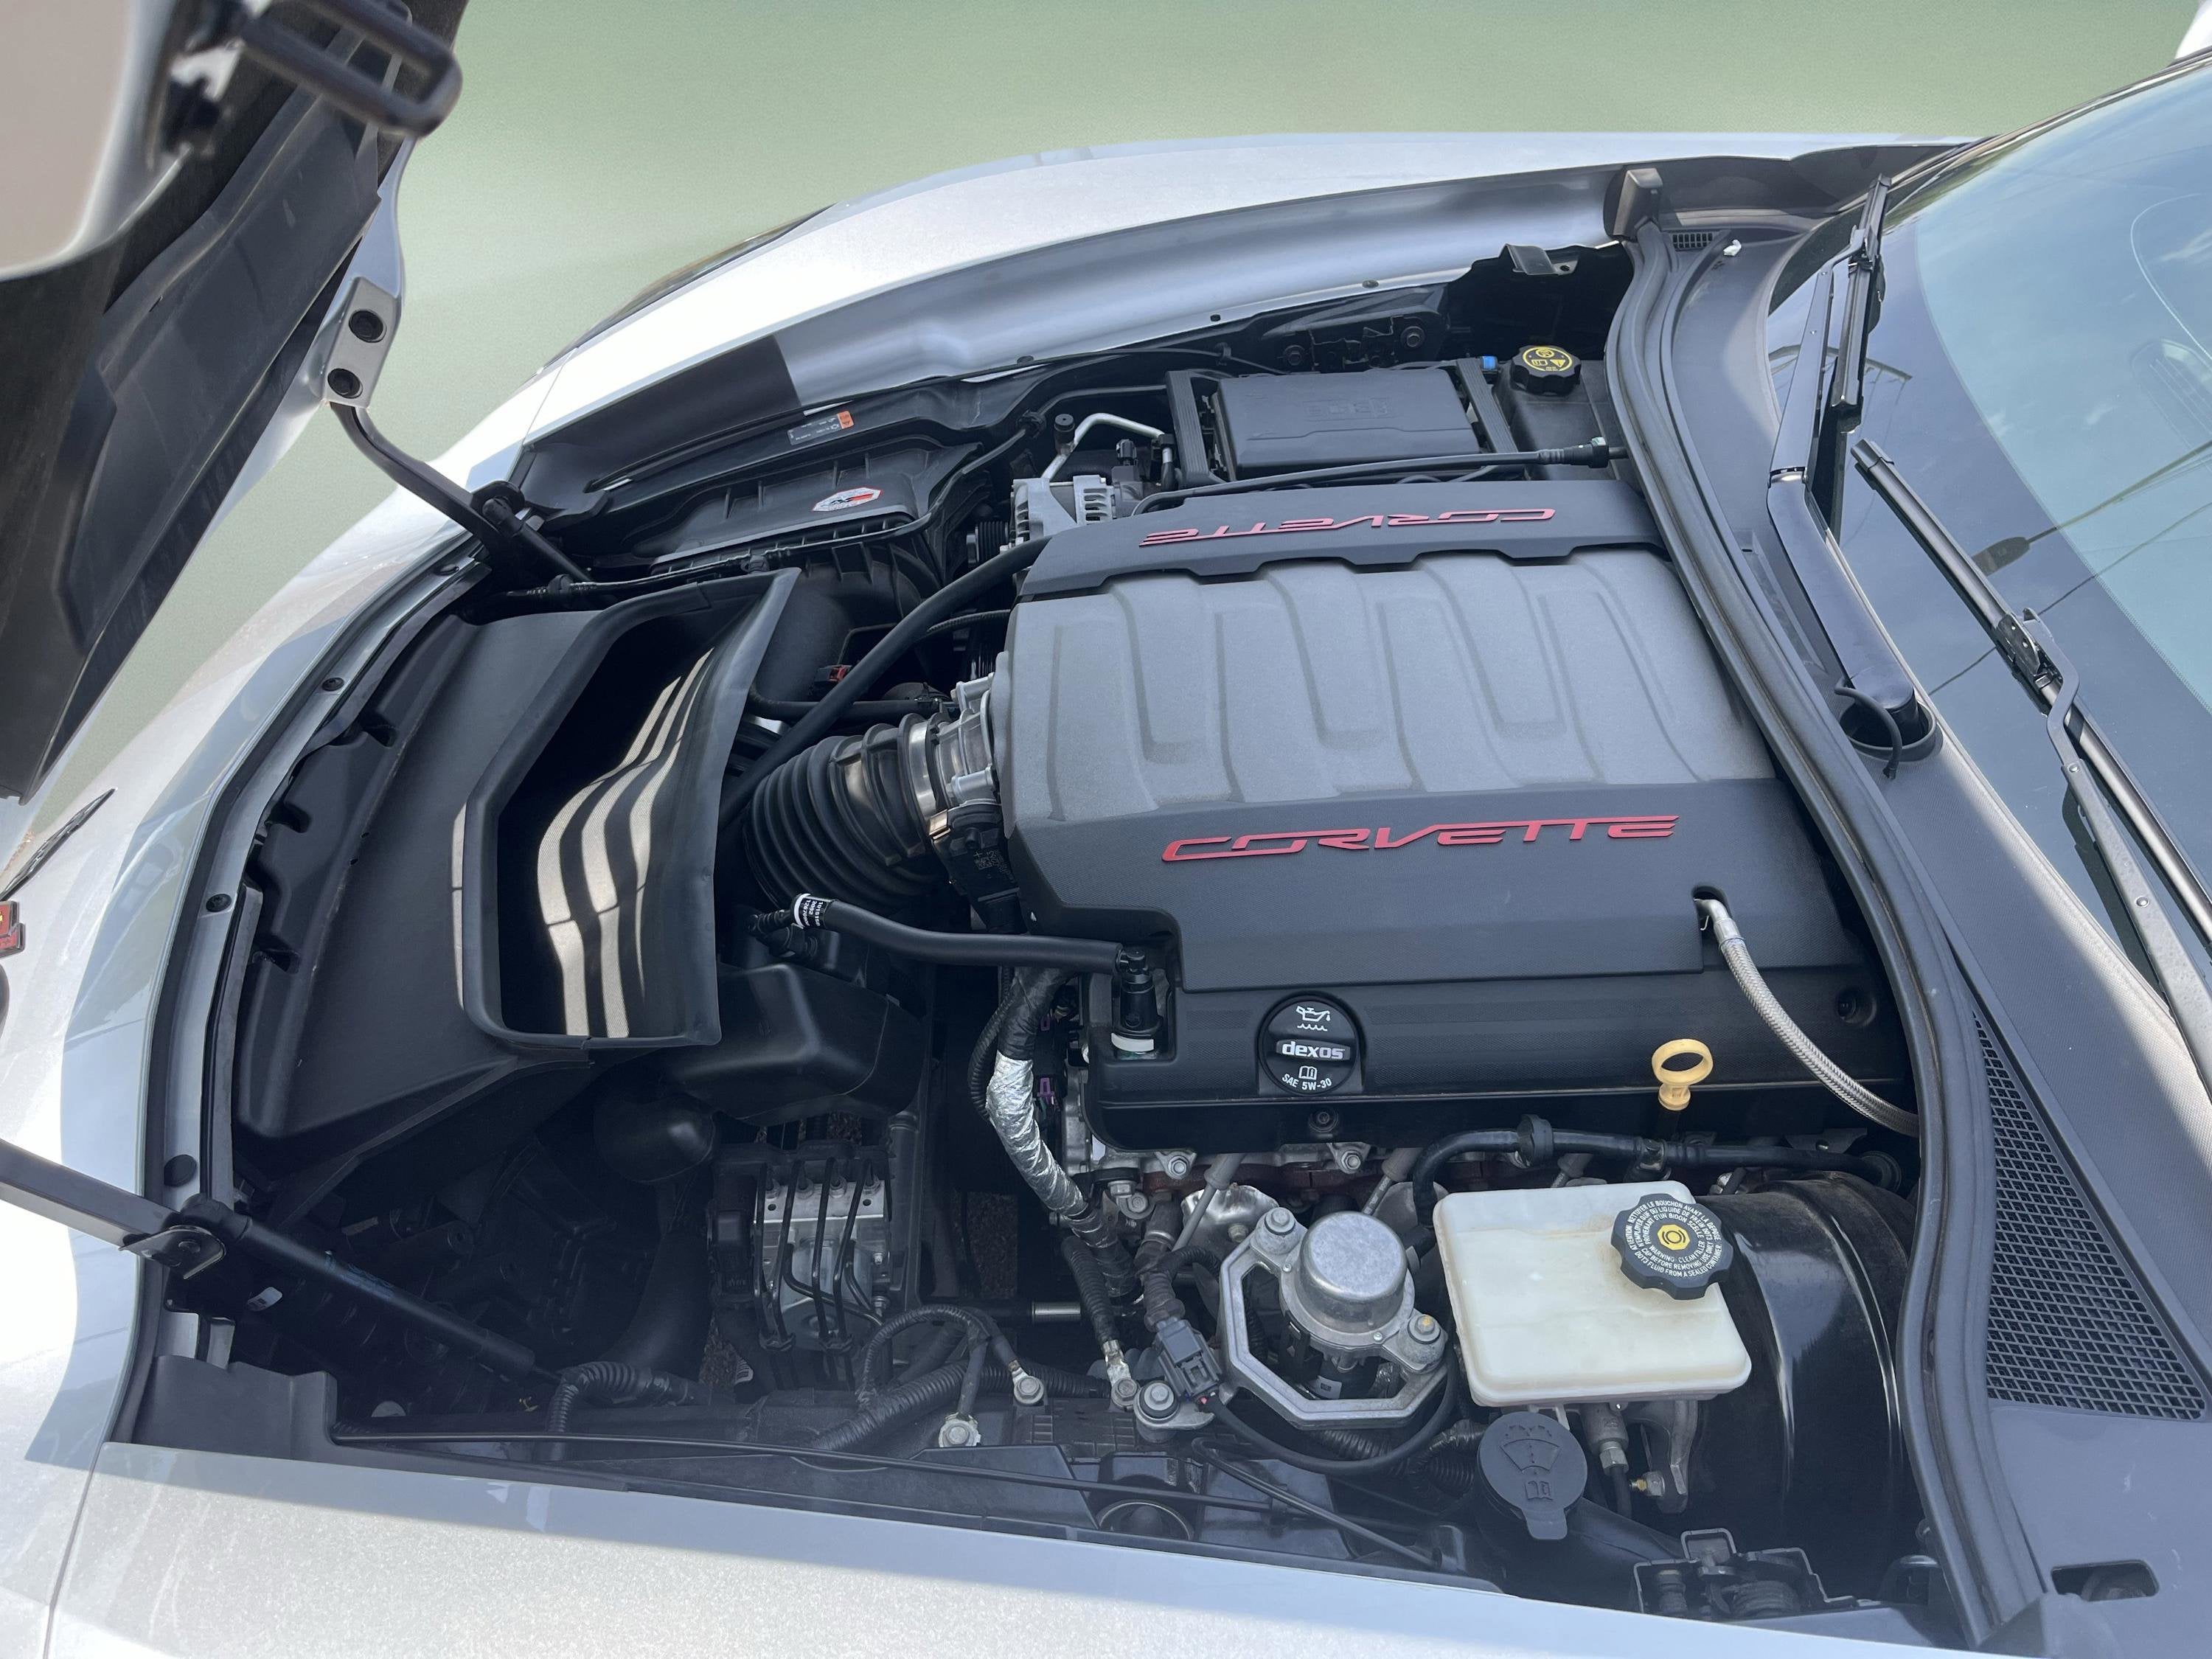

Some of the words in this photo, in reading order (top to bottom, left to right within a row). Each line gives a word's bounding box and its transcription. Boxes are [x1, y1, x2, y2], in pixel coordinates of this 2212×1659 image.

[1138, 507, 1556, 548] CORVETTE
[1161, 814, 1680, 863] CORVETTE
[1282, 1040, 1345, 1060] dexos
[1282, 1074, 1299, 1088] SAE
[1301, 1077, 1332, 1090] 5W-30
[1646, 1200, 1656, 1208] LE
[1655, 1200, 1683, 1208] BOUCHON
[1683, 1205, 1703, 1217] AVANT
[1700, 1214, 1710, 1223] LA
[1649, 1207, 1659, 1215] DU
[1658, 1206, 1681, 1214] LIQUIDE
[1689, 1214, 1706, 1228] FREIN
[1668, 1212, 1688, 1223] BIDON
[1686, 1220, 1705, 1239] SCELLE
[1634, 1251, 1649, 1264] DOT3
[1646, 1261, 1665, 1273] FLUID
[1664, 1268, 1683, 1277] FROM
[1687, 1265, 1708, 1277] SEALED
[1641, 1248, 1653, 1256] CAP
[1649, 1254, 1673, 1269] BEFORE
[1700, 1252, 1711, 1263] USE
[1677, 1253, 1697, 1263] CLEAN
